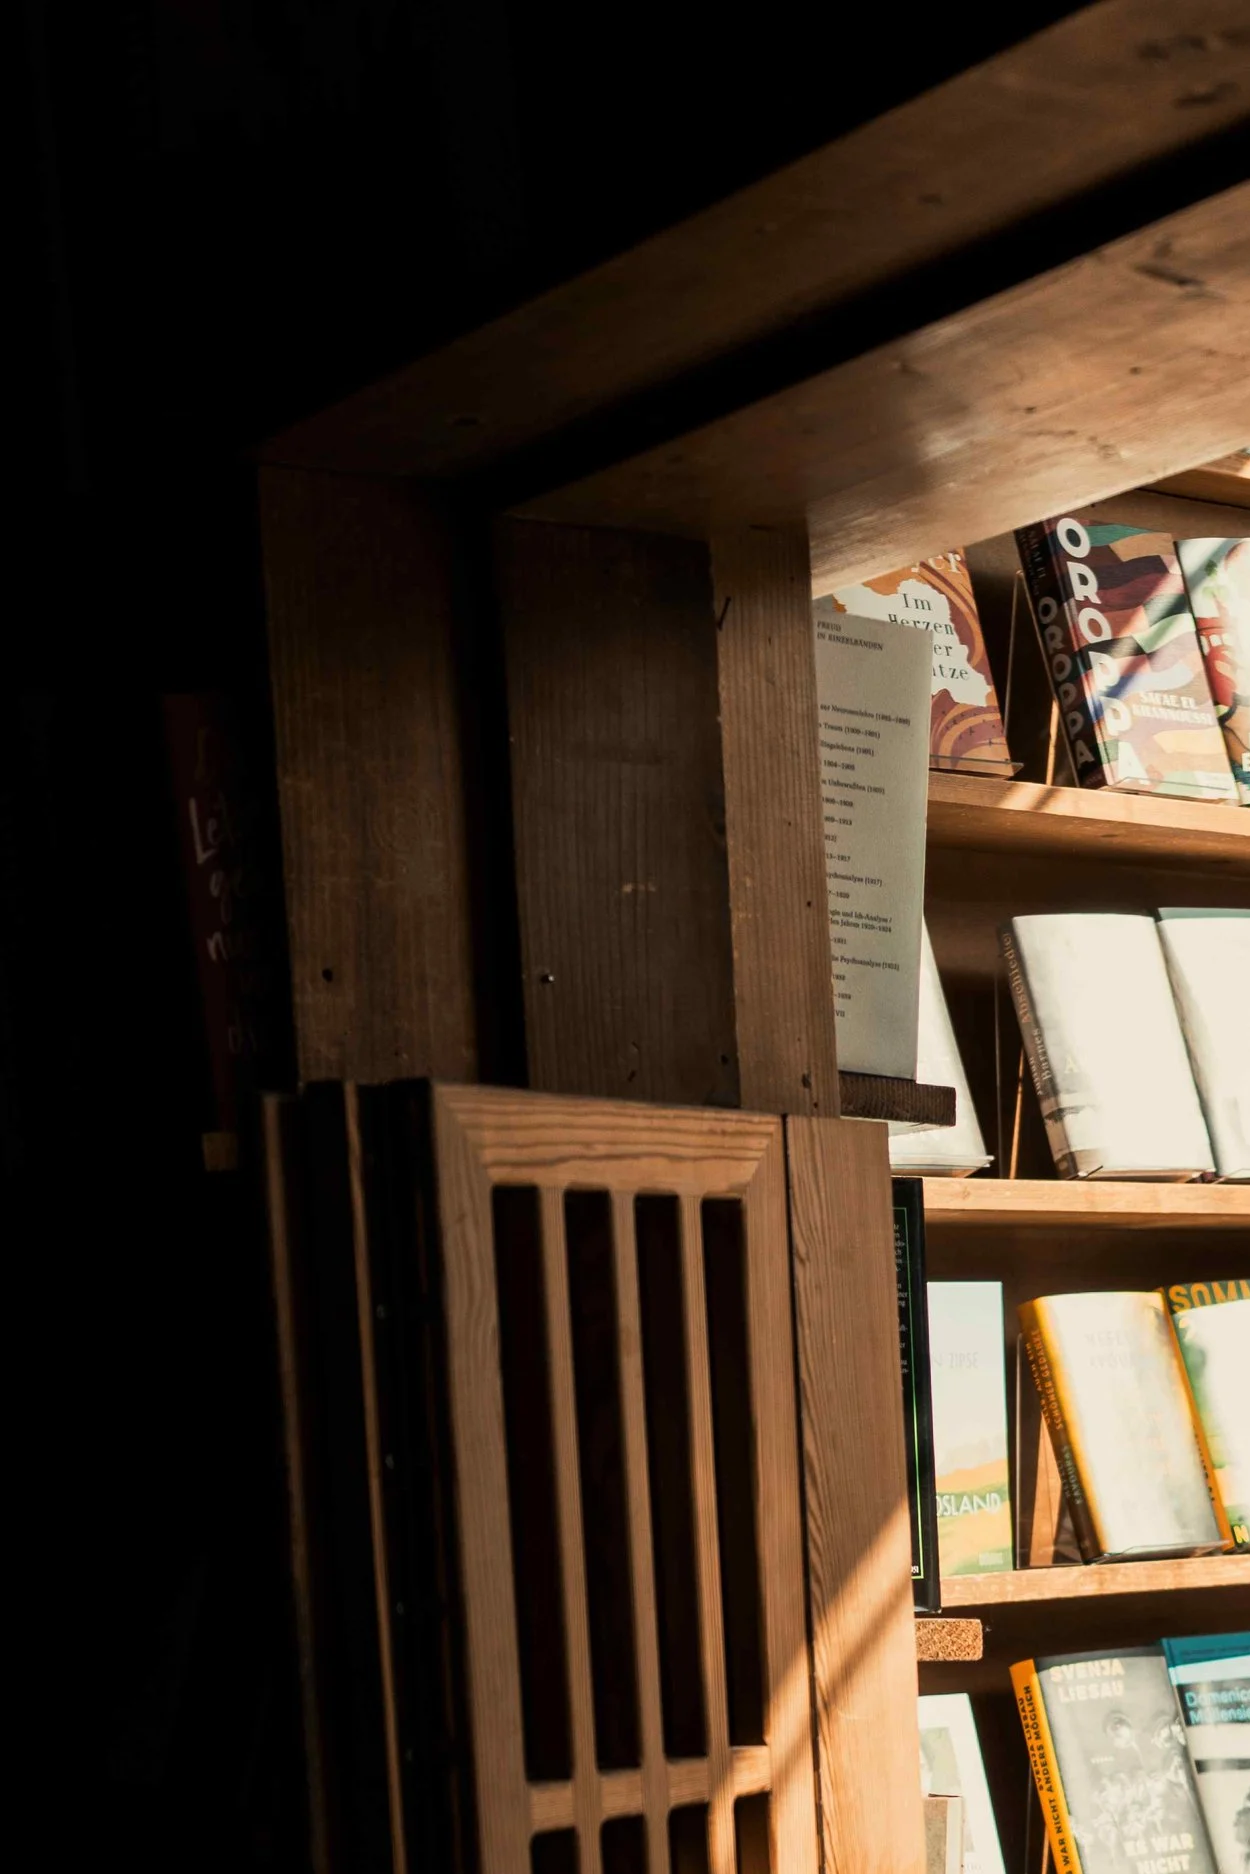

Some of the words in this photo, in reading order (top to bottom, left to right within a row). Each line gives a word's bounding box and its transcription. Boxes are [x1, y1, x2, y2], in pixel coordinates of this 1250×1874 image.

[901, 593, 933, 611] Im
[932, 644, 954, 657] er
[1055, 517, 1151, 786] OROPPA
[1037, 596, 1095, 770] OROPPA
[1050, 1658, 1125, 1682] SVENJA
[1058, 1680, 1125, 1703] LIESAU
[1018, 1697, 1034, 1741] LIESAU
[1024, 1685, 1042, 1741] MÖGLICH
[1031, 1744, 1044, 1791] SVENJA
[1039, 1744, 1055, 1794] ANDERS
[1050, 1801, 1063, 1834] NICHT
[1058, 1838, 1070, 1867] WAR
[1124, 1840, 1147, 1857] ES
[1150, 1833, 1194, 1853] WAR
